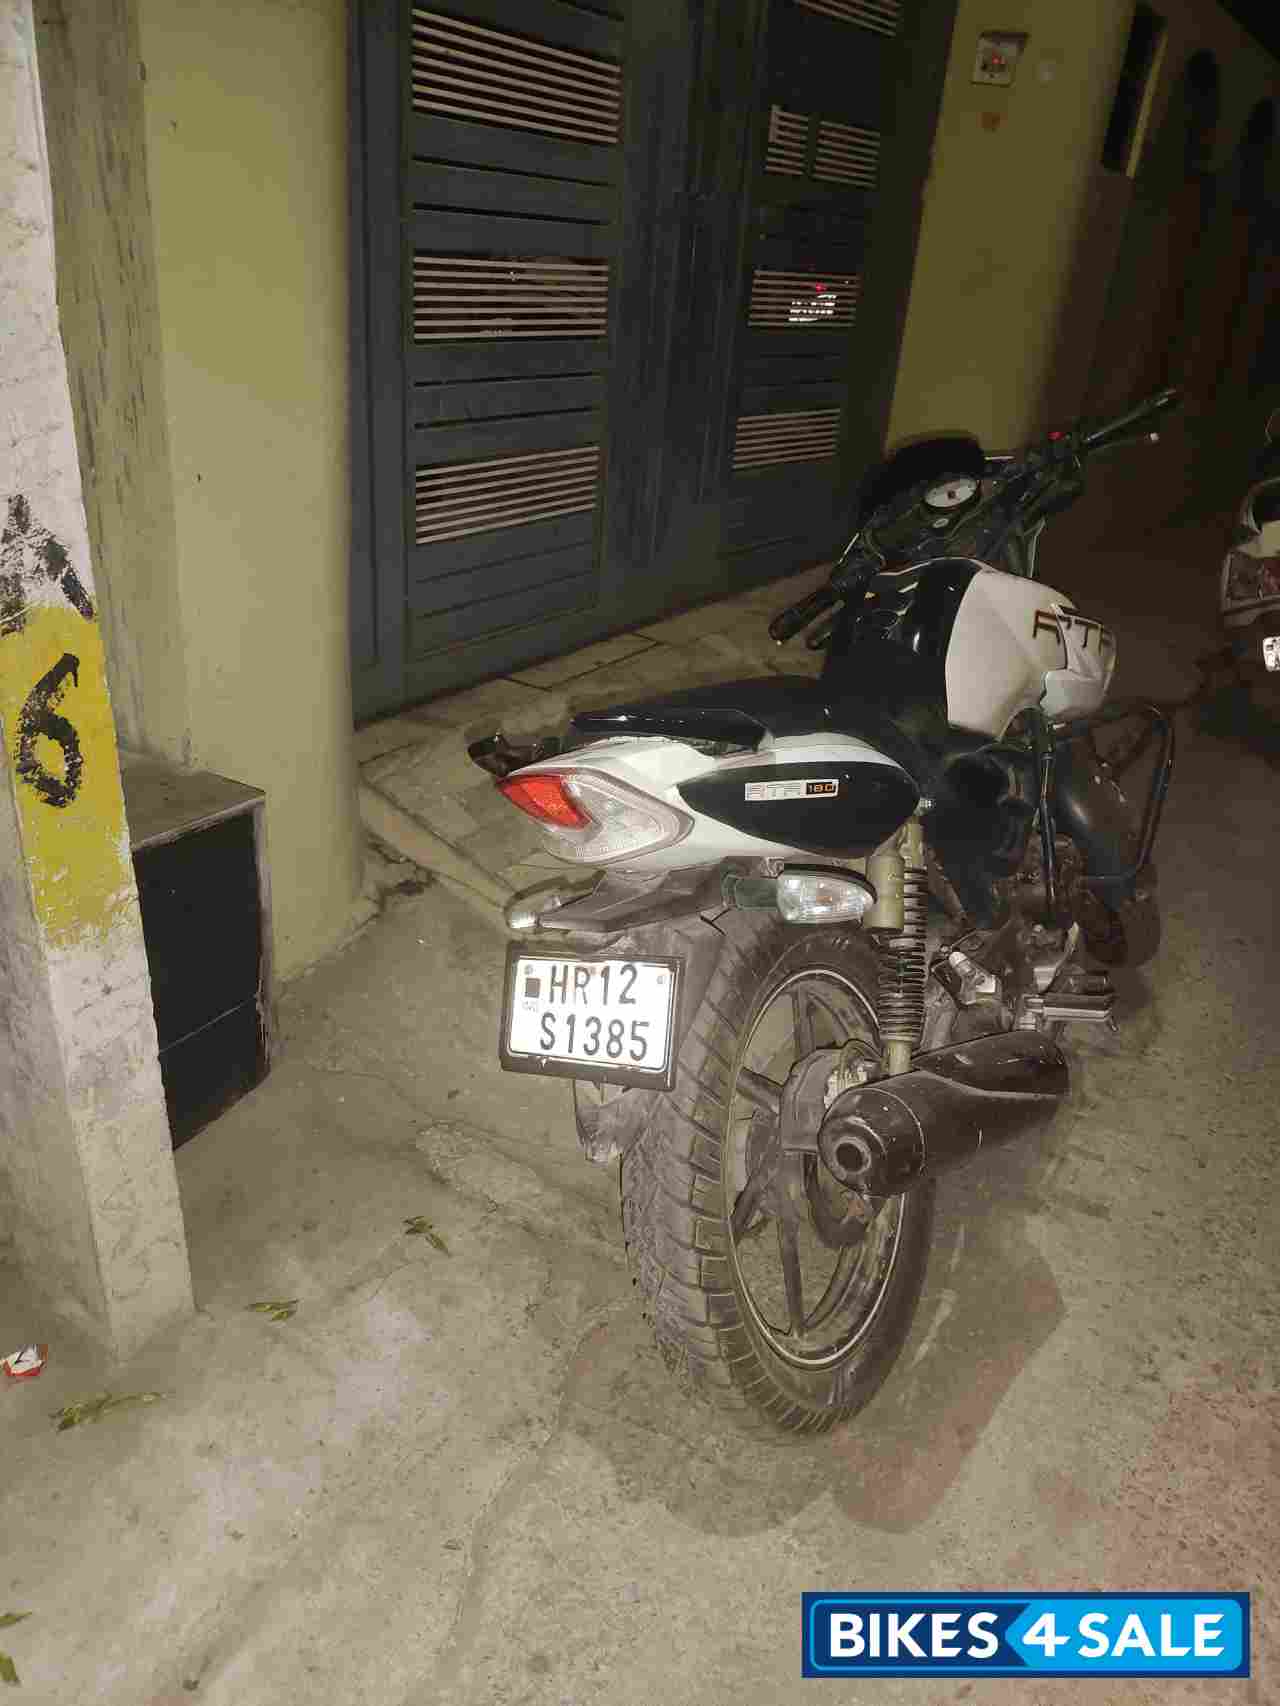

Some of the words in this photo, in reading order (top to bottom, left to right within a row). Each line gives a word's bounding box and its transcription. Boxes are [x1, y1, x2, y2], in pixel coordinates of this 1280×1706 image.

[14, 652, 85, 808] 6
[549, 964, 637, 1005] HR12
[540, 1012, 650, 1061] S1385
